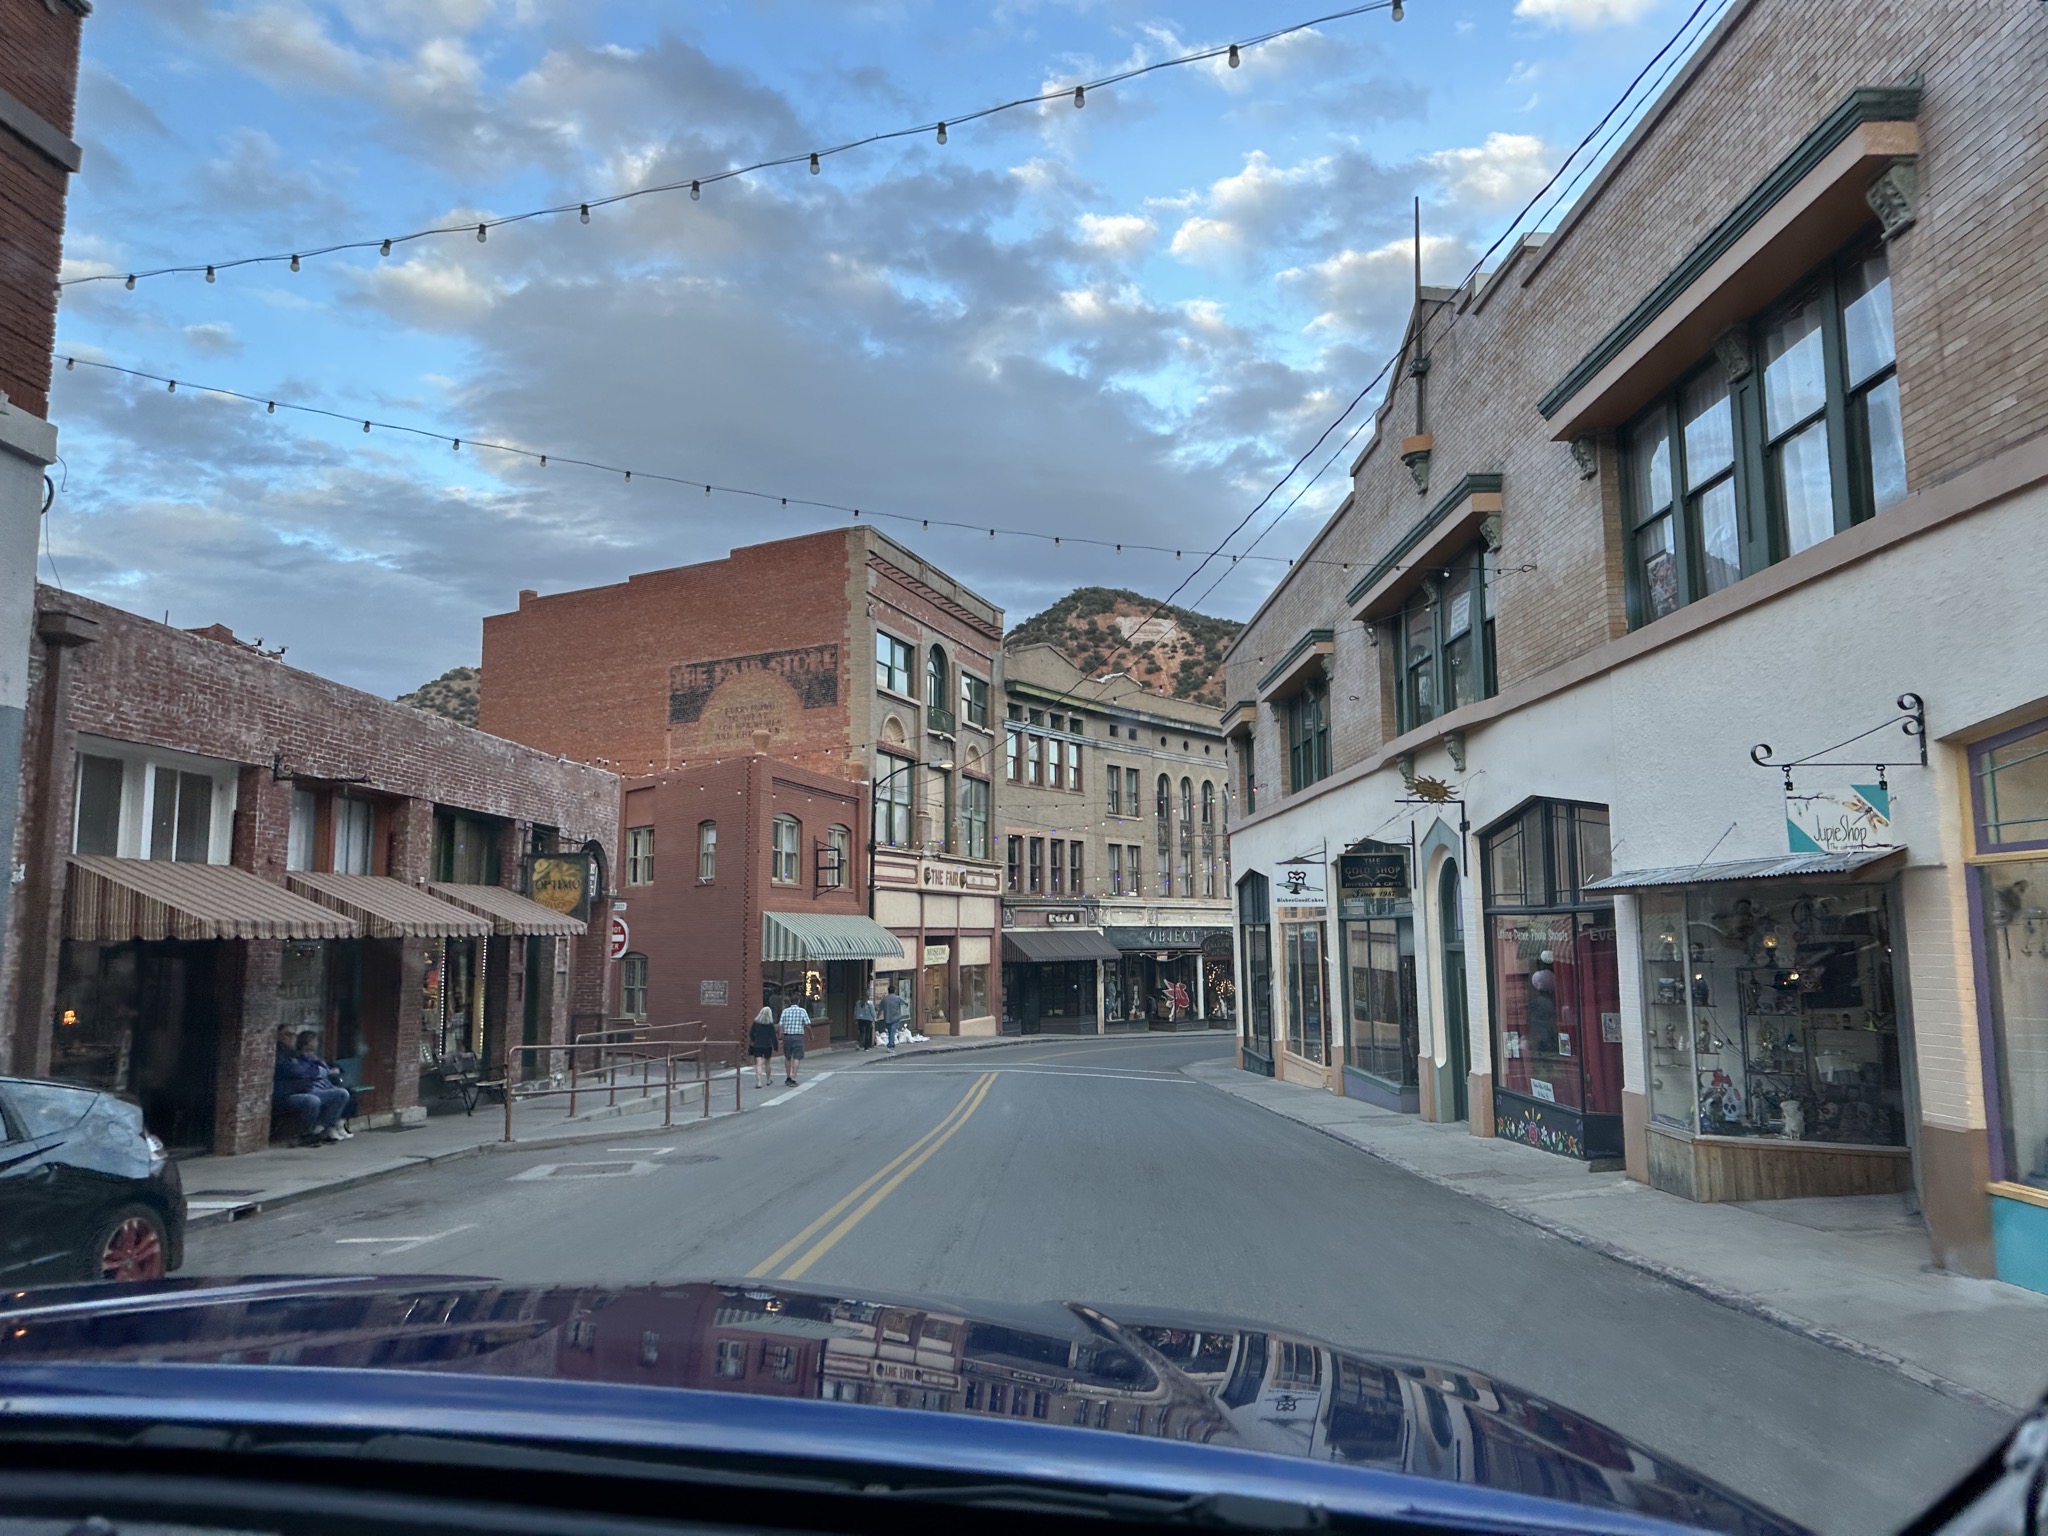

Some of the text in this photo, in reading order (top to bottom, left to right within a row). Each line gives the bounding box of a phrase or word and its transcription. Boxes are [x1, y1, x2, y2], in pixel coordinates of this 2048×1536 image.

[768, 649, 837, 677] STORE
[1345, 866, 1401, 875] GOLD SHOP
[931, 869, 959, 887] THE FAIR
[535, 879, 581, 891] OPTIMO
[1352, 888, 1396, 898] Since 1987
[1149, 930, 1198, 943] OBJECT
